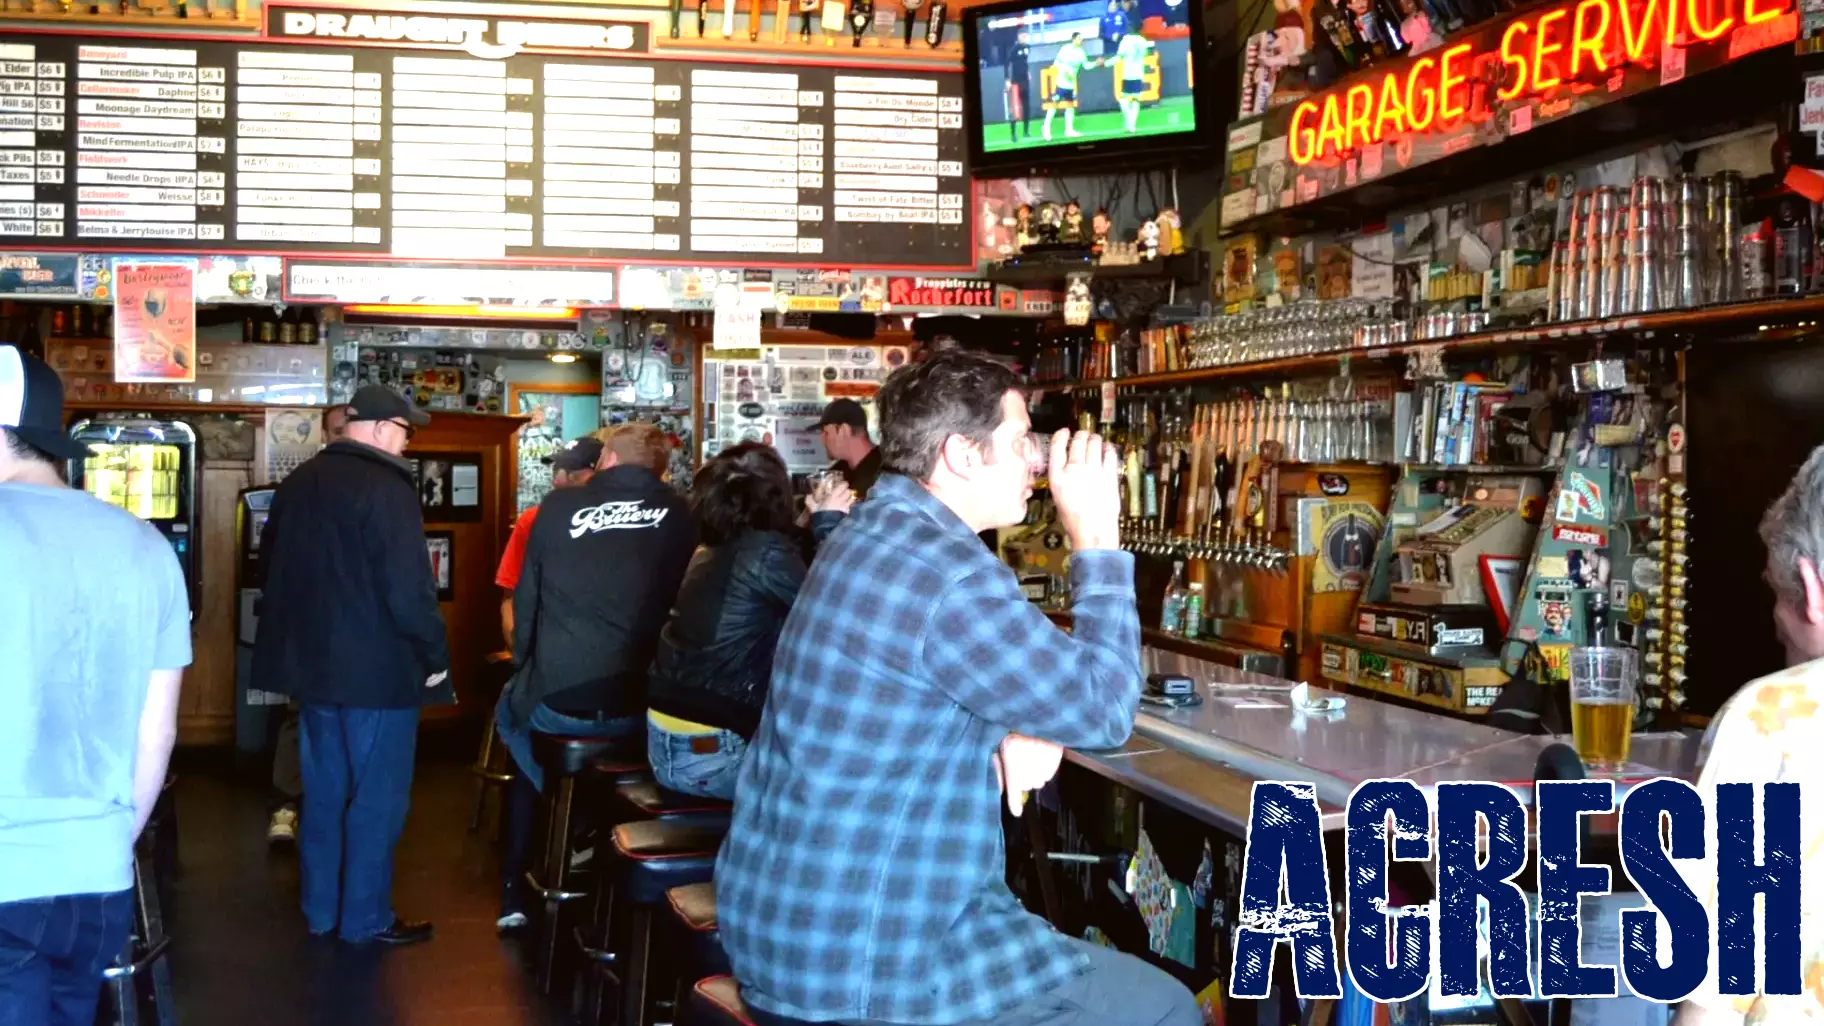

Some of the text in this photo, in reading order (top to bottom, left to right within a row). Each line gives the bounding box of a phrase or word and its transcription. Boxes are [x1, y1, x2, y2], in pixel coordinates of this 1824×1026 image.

[284, 12, 635, 50] DRAUGHT BEERS
[5, 63, 32, 74] Elder
[100, 67, 194, 80] Incredible Pulp IPA
[14, 82, 31, 92] IPA
[158, 88, 196, 99] Daphne
[96, 102, 194, 117] Moonage Daydream
[1288, 43, 1472, 165] GARAGE
[83, 136, 108, 146] Mind
[13, 153, 32, 163] Pils
[1, 170, 30, 180] Taxes
[106, 171, 140, 182] Needle
[143, 174, 171, 184] Drops
[158, 191, 193, 201] Weisse
[2, 222, 33, 232] White
[78, 224, 109, 234] Belma
[177, 227, 194, 236] IPA
[890, 279, 993, 306] Rochefort
[852, 348, 871, 360] ALE
[1465, 687, 1485, 697] THE
